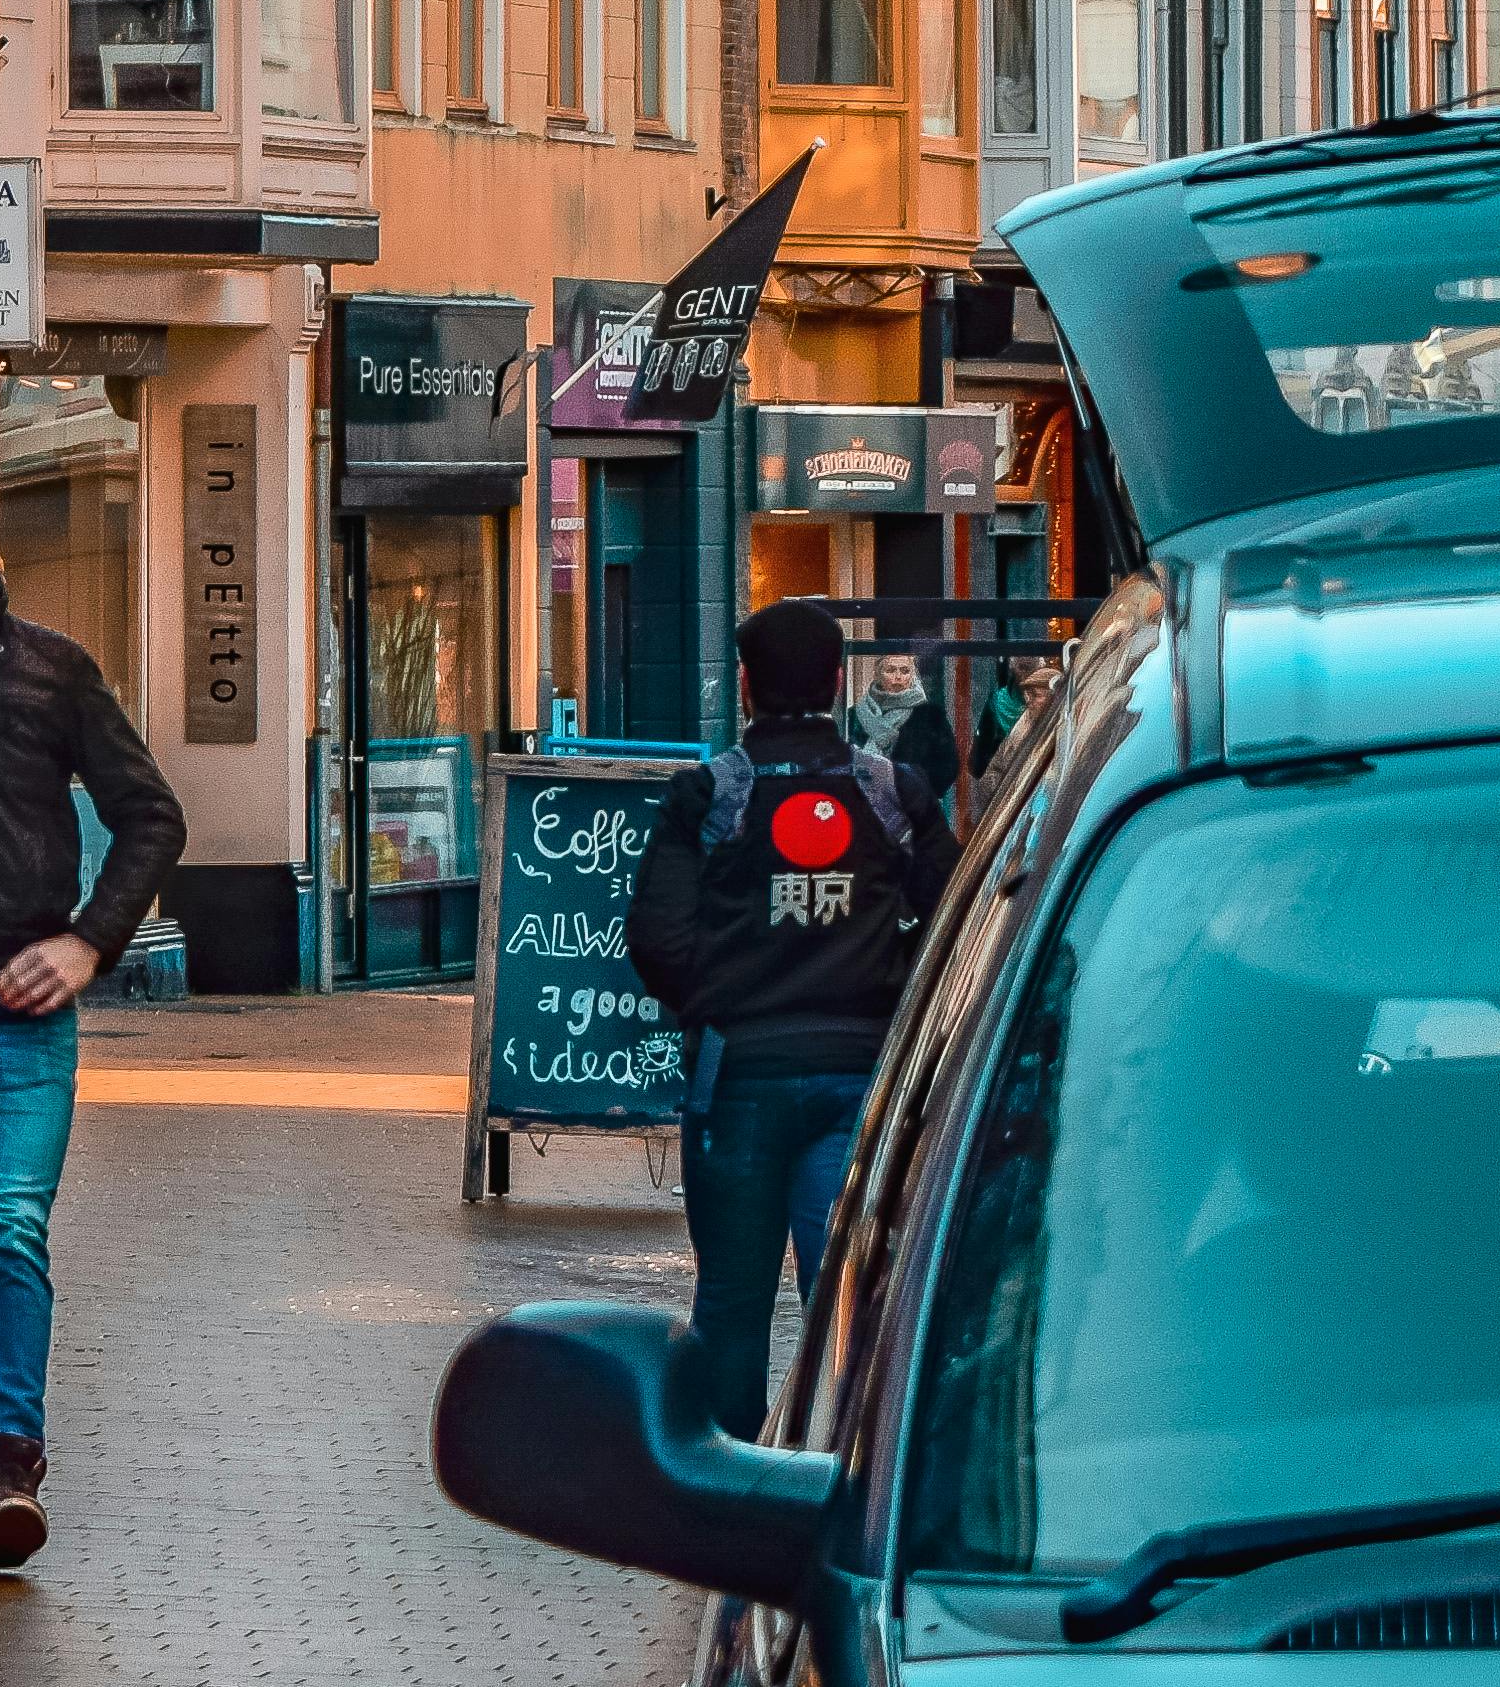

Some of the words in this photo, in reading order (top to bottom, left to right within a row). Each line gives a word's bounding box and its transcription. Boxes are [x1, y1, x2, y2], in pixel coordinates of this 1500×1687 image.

[360, 356, 402, 394] Pure
[410, 358, 496, 396] Essentials
[208, 442, 244, 492] in
[532, 787, 650, 874] Coffe
[506, 912, 630, 958] ALW
[538, 985, 560, 1014] a
[529, 1040, 640, 1086] idea
